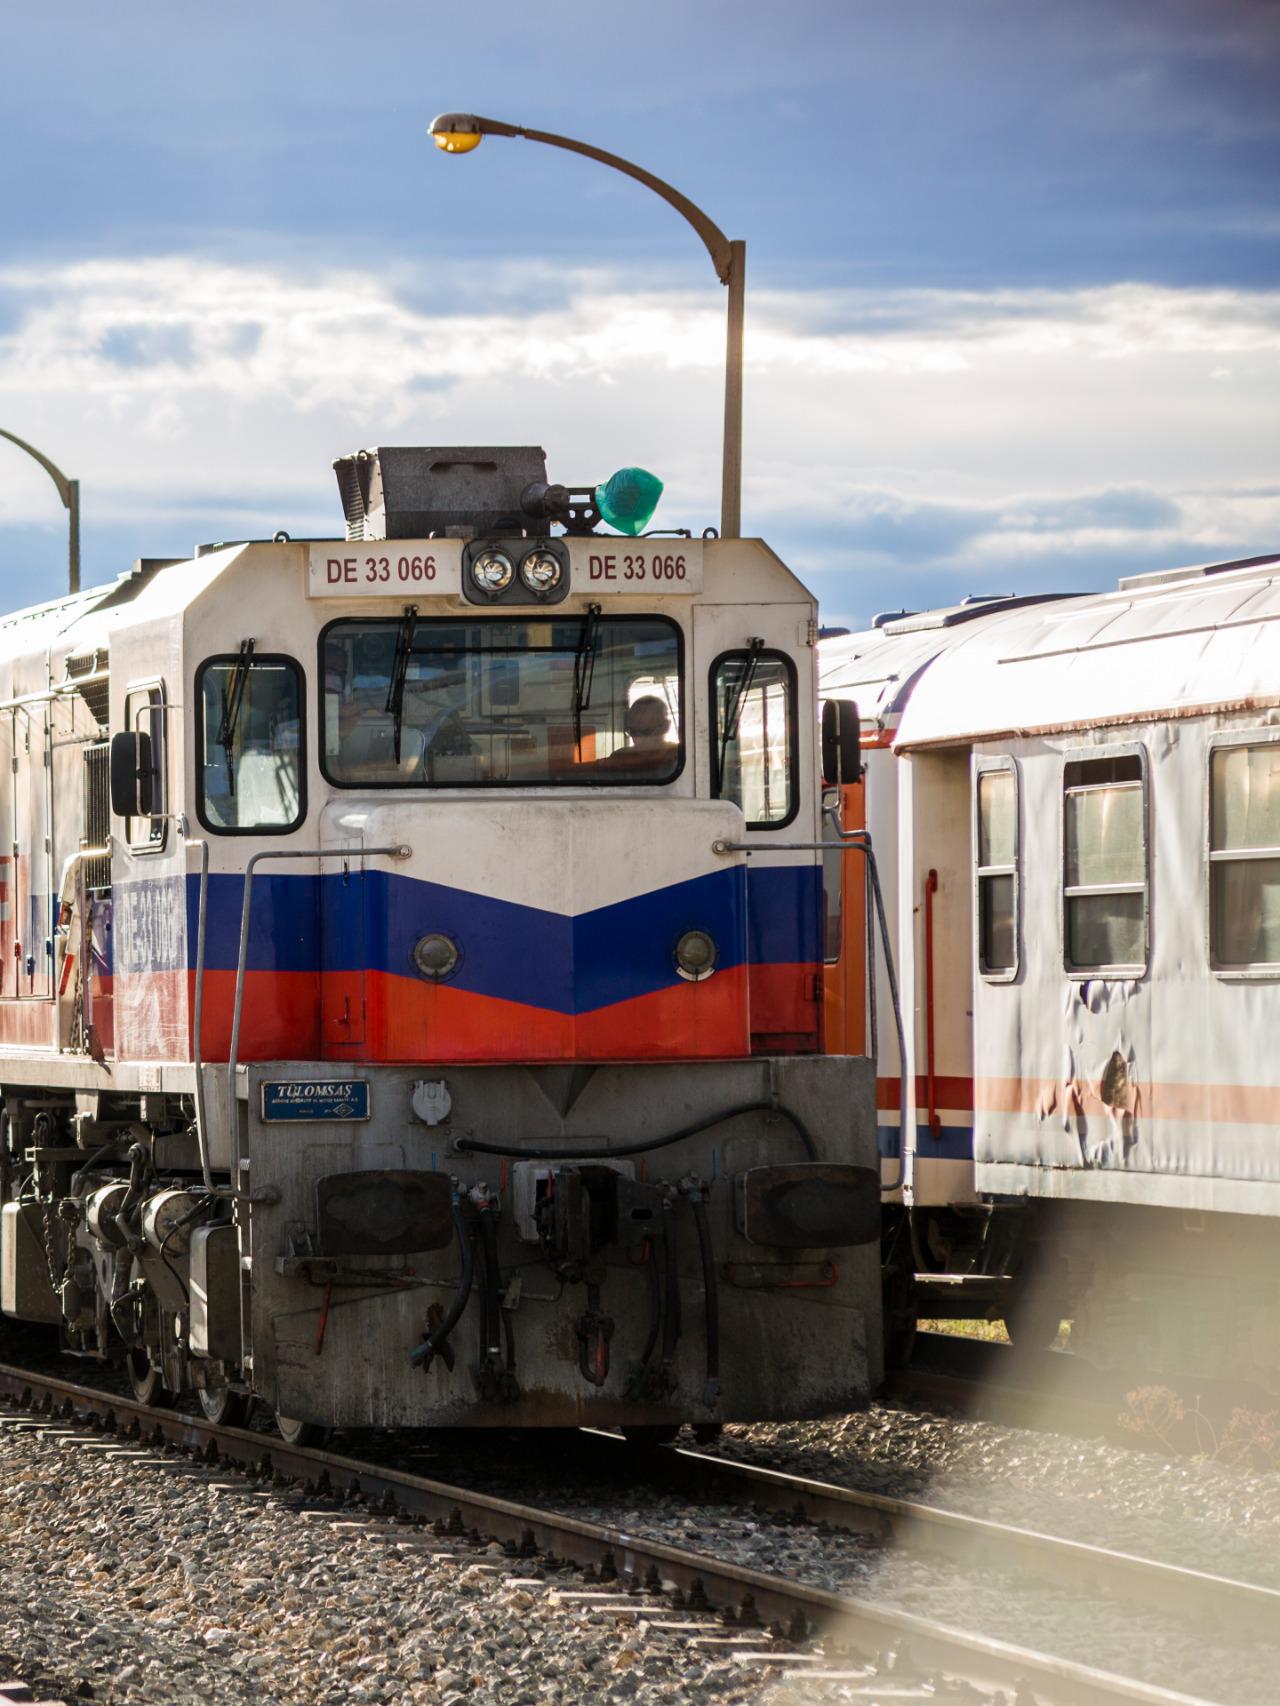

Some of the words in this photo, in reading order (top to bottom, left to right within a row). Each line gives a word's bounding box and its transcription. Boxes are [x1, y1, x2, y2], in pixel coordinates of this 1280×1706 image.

[327, 558, 358, 583] DE
[365, 557, 390, 582] 33
[398, 556, 436, 581] 066
[589, 555, 617, 579] DE
[623, 555, 646, 580] 33
[652, 555, 686, 580] 066
[122, 892, 138, 964] DE
[140, 889, 153, 964] 33
